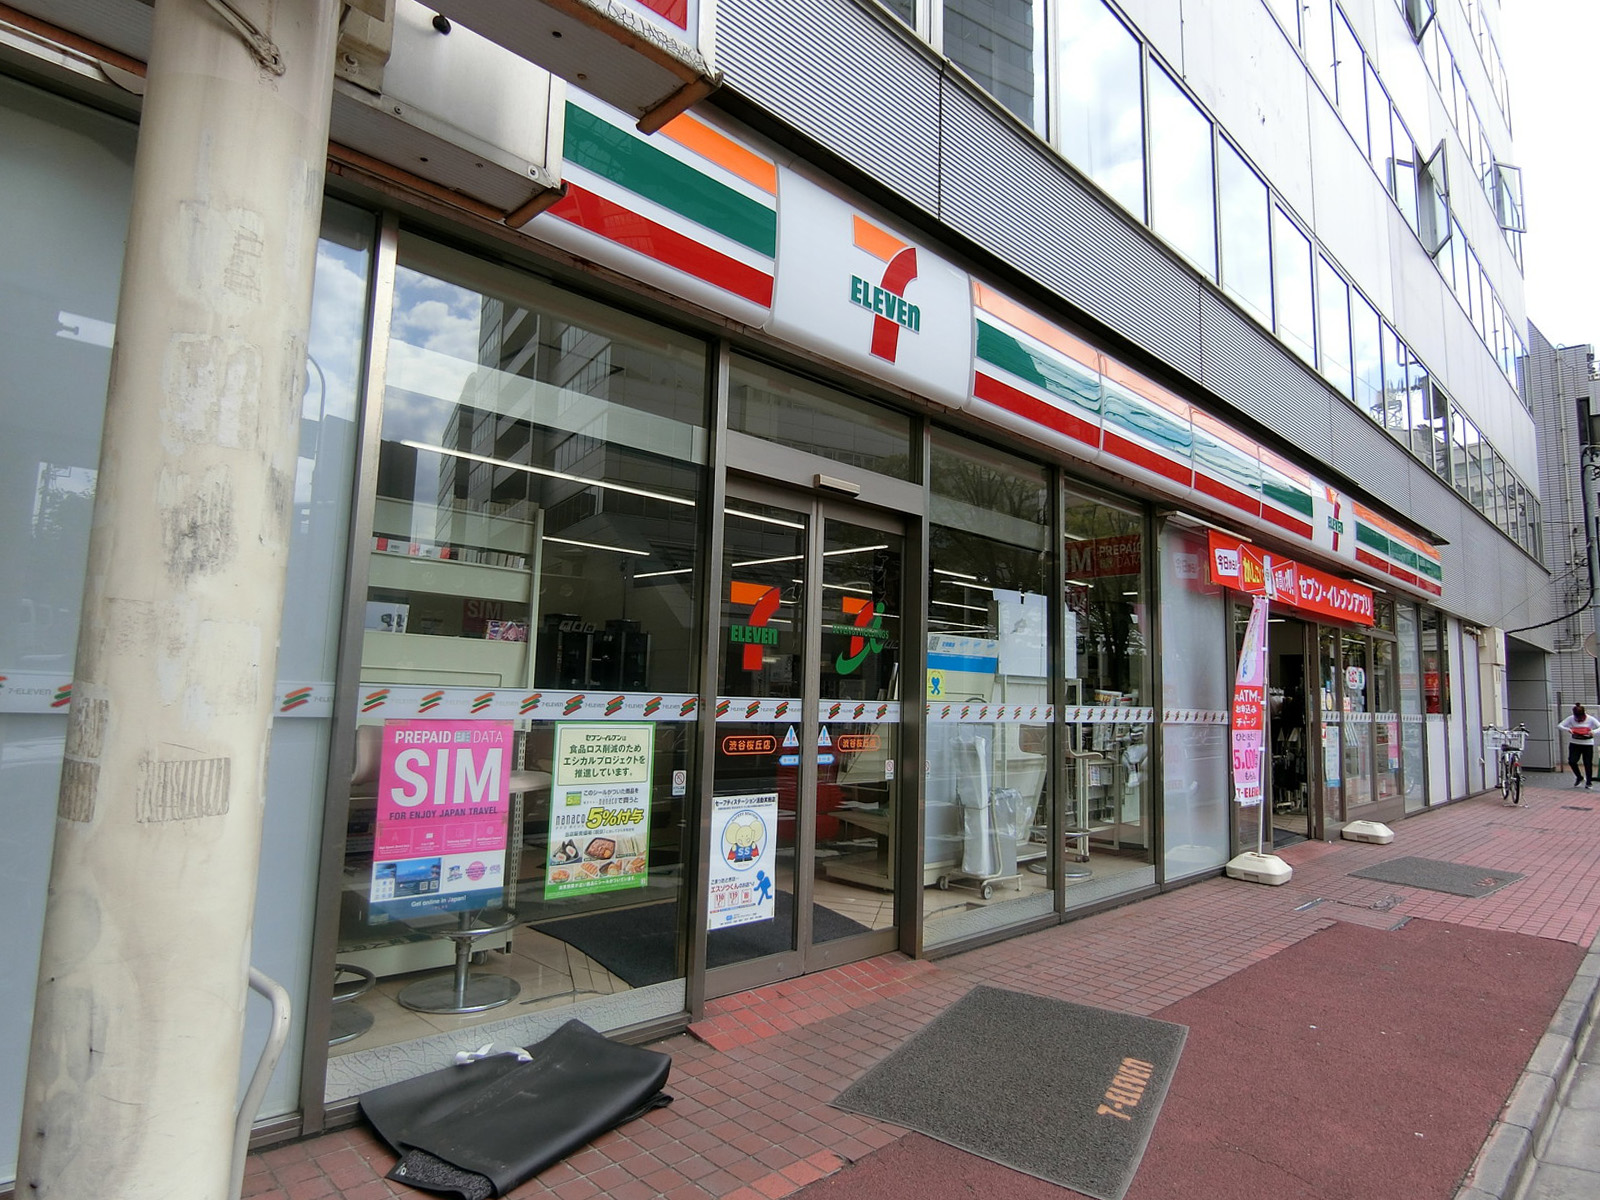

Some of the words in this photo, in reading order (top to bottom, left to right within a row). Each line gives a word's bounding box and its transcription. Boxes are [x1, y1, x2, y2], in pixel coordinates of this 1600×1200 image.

[850, 274, 921, 333] ELEVEN
[467, 599, 503, 621] SIM
[731, 625, 779, 645] ELEVEN
[394, 730, 452, 744] PREPAID
[473, 730, 504, 743] DATA
[842, 738, 877, 748] 渋谷桜丘店
[569, 744, 642, 754] 食品ロス削減のため
[728, 739, 771, 751] 渋谷桜丘店
[563, 755, 646, 766] エシカルプロジェクトを
[390, 747, 503, 807] SIM
[574, 767, 633, 778] 推進しています。
[389, 811, 407, 821] FOR
[409, 809, 437, 820] ENJOY
[439, 808, 466, 818] JAPAN
[469, 806, 498, 815] TRAVEL
[555, 813, 586, 826] nanaco
[585, 807, 645, 829] 5%付与
[411, 900, 422, 908] Get
[422, 897, 440, 906] online
[441, 896, 447, 904] in
